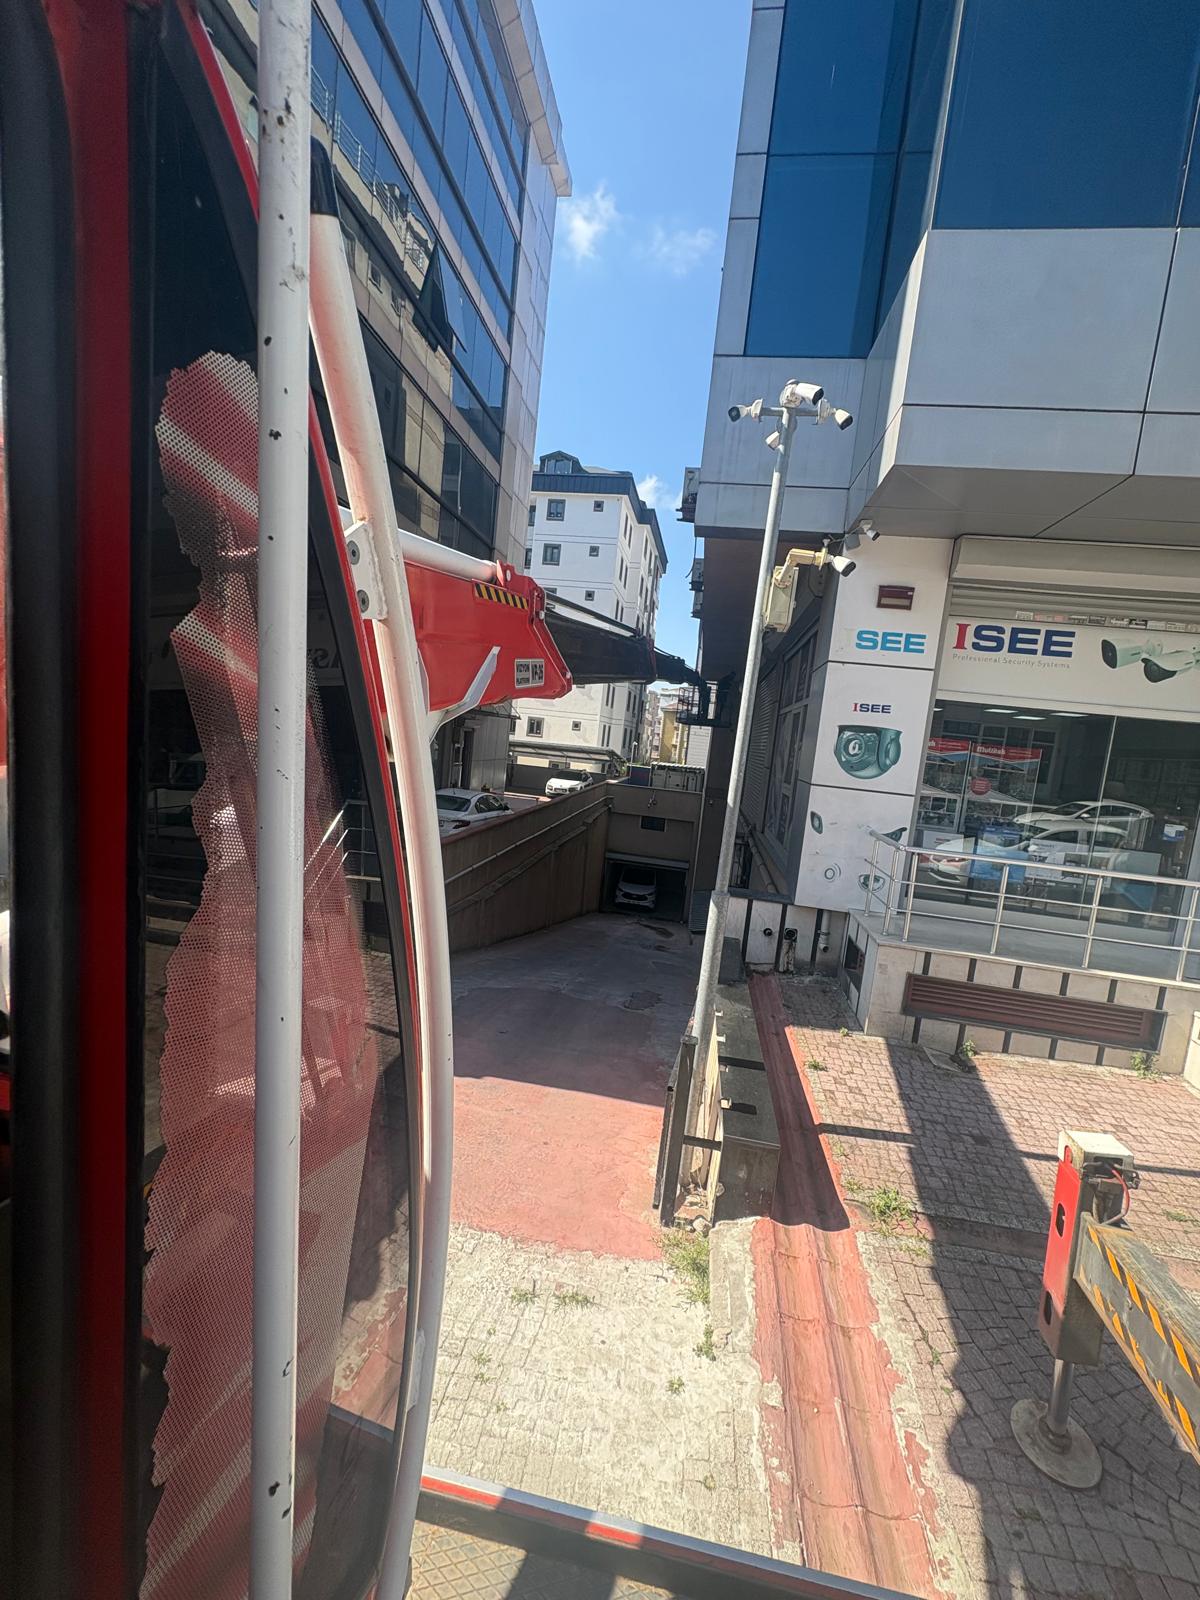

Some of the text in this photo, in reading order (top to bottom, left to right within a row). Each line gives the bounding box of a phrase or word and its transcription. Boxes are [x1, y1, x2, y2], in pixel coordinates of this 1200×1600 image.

[952, 623, 1076, 658] ISEE
[952, 653, 1071, 669] Professional Security Systems
[852, 702, 892, 714] ISEE
